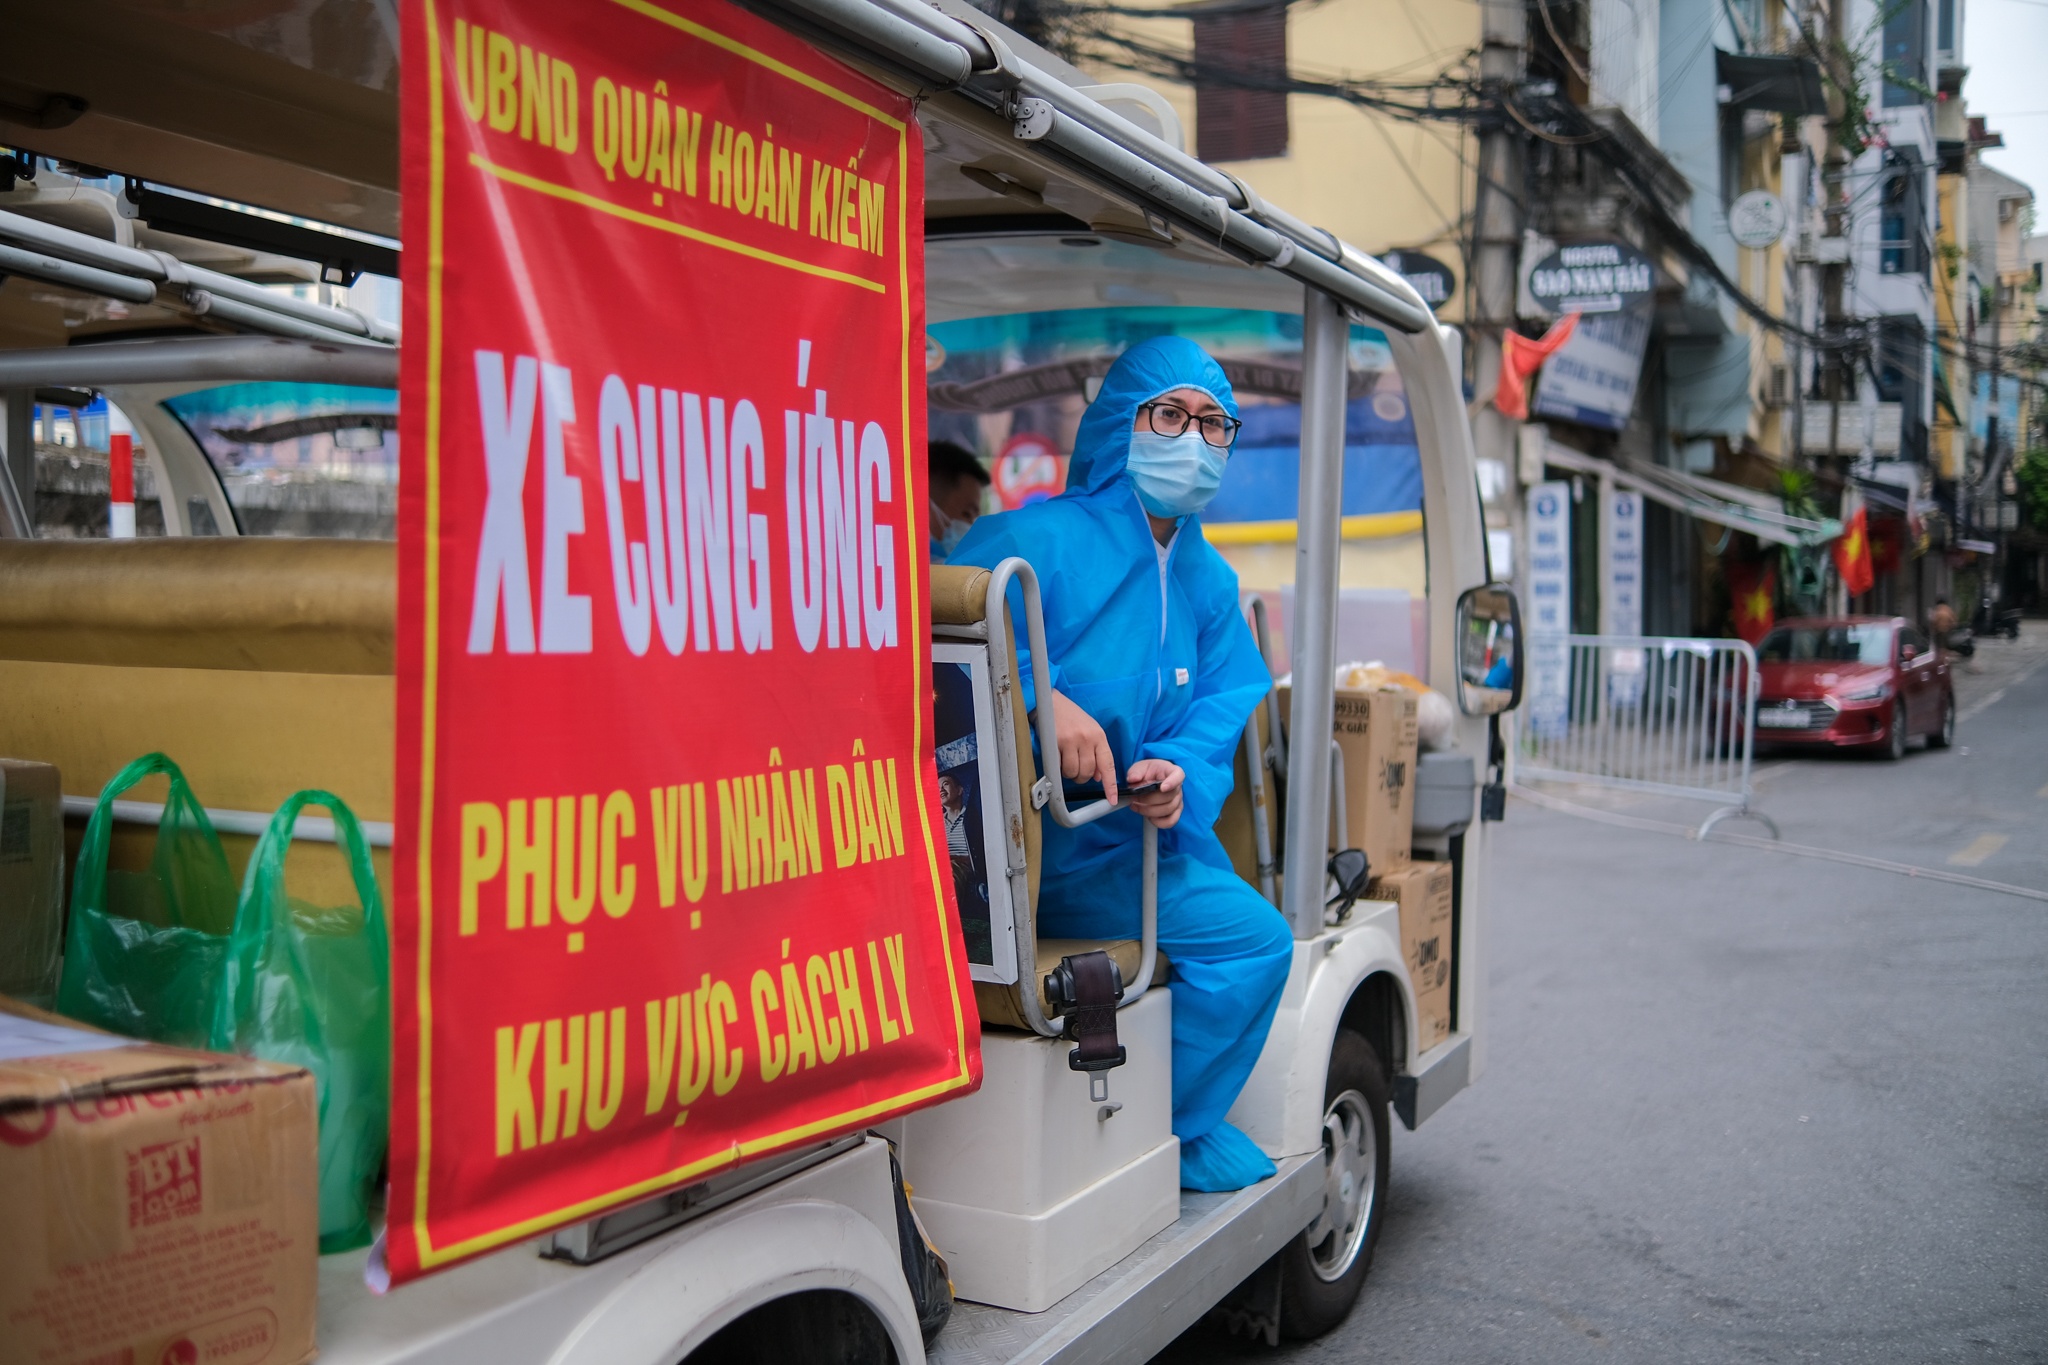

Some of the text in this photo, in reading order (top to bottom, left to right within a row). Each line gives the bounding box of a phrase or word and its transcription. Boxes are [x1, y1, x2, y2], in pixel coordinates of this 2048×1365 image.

[454, 17, 885, 258] UBND QUẬN HOÀN KIẾM
[1560, 244, 1621, 267] HOSTEL
[466, 338, 898, 657] XE CUNG ỨNG
[459, 738, 906, 953] PHỤC VỤ NHÂN DÂN
[496, 932, 915, 1158] KHU VỰC CÁCH LY
